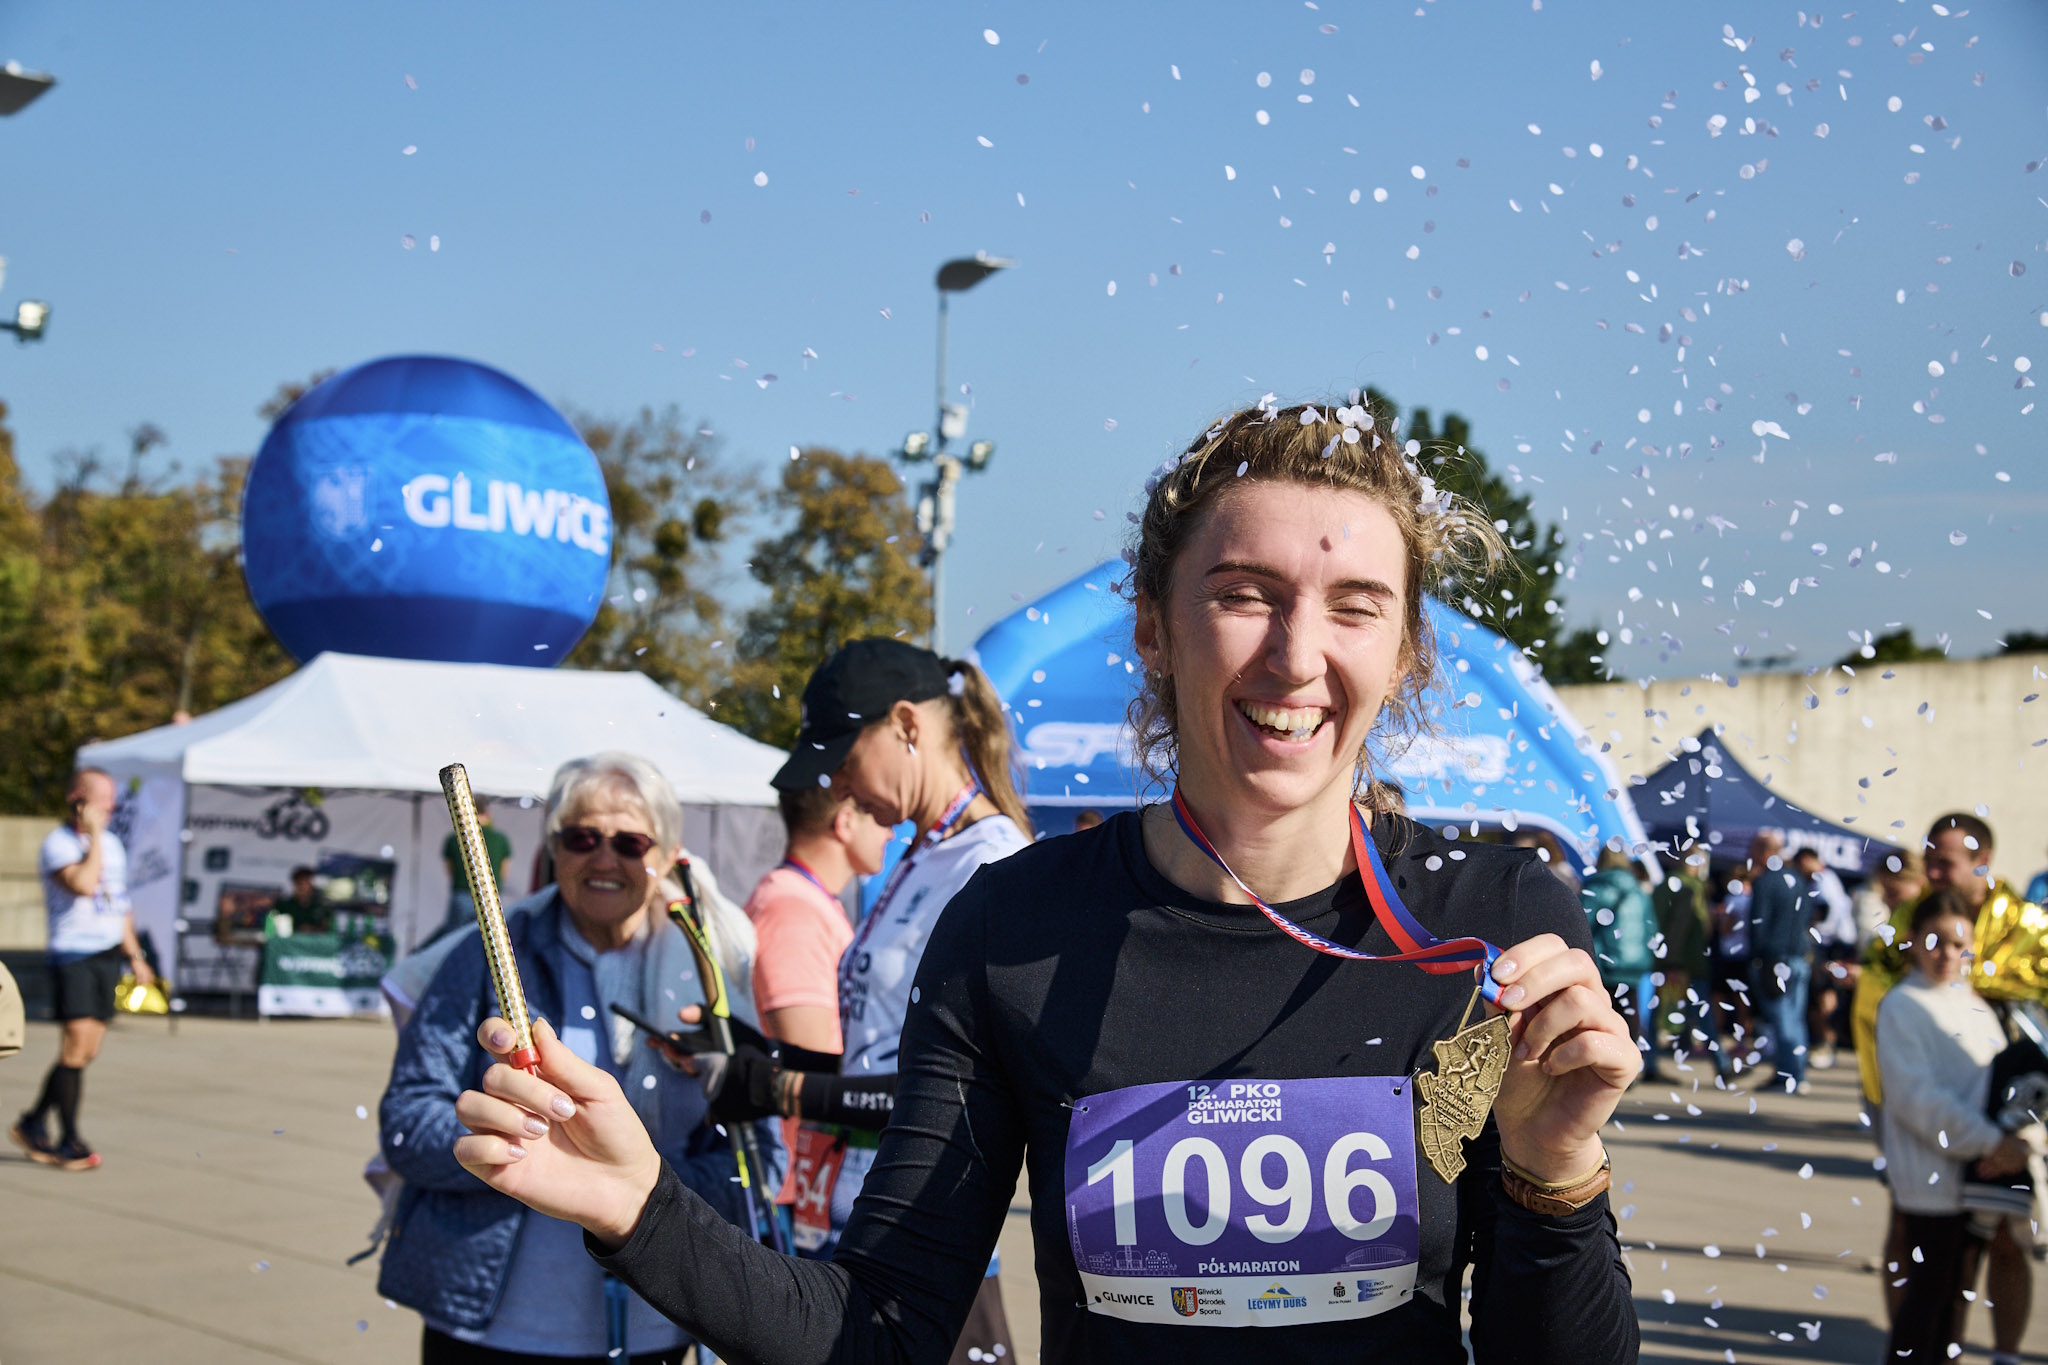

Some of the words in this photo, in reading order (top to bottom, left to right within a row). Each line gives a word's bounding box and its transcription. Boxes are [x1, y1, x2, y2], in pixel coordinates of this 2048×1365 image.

[403, 473, 608, 556] GLIWICE
[1187, 1085, 1217, 1099] 12.
[1230, 1083, 1281, 1099] PKO
[1188, 1098, 1281, 1111] PÓŁMARATON
[1187, 1108, 1282, 1124] GLIWICKI
[1087, 1131, 1398, 1246] 1096
[1198, 1258, 1300, 1274] PÓŁMARATON
[1102, 1291, 1155, 1306] GLIWICE
[1198, 1298, 1226, 1306] Ośrodek
[1248, 1298, 1281, 1310] LECYMY
[1199, 1308, 1222, 1316] Sportu
